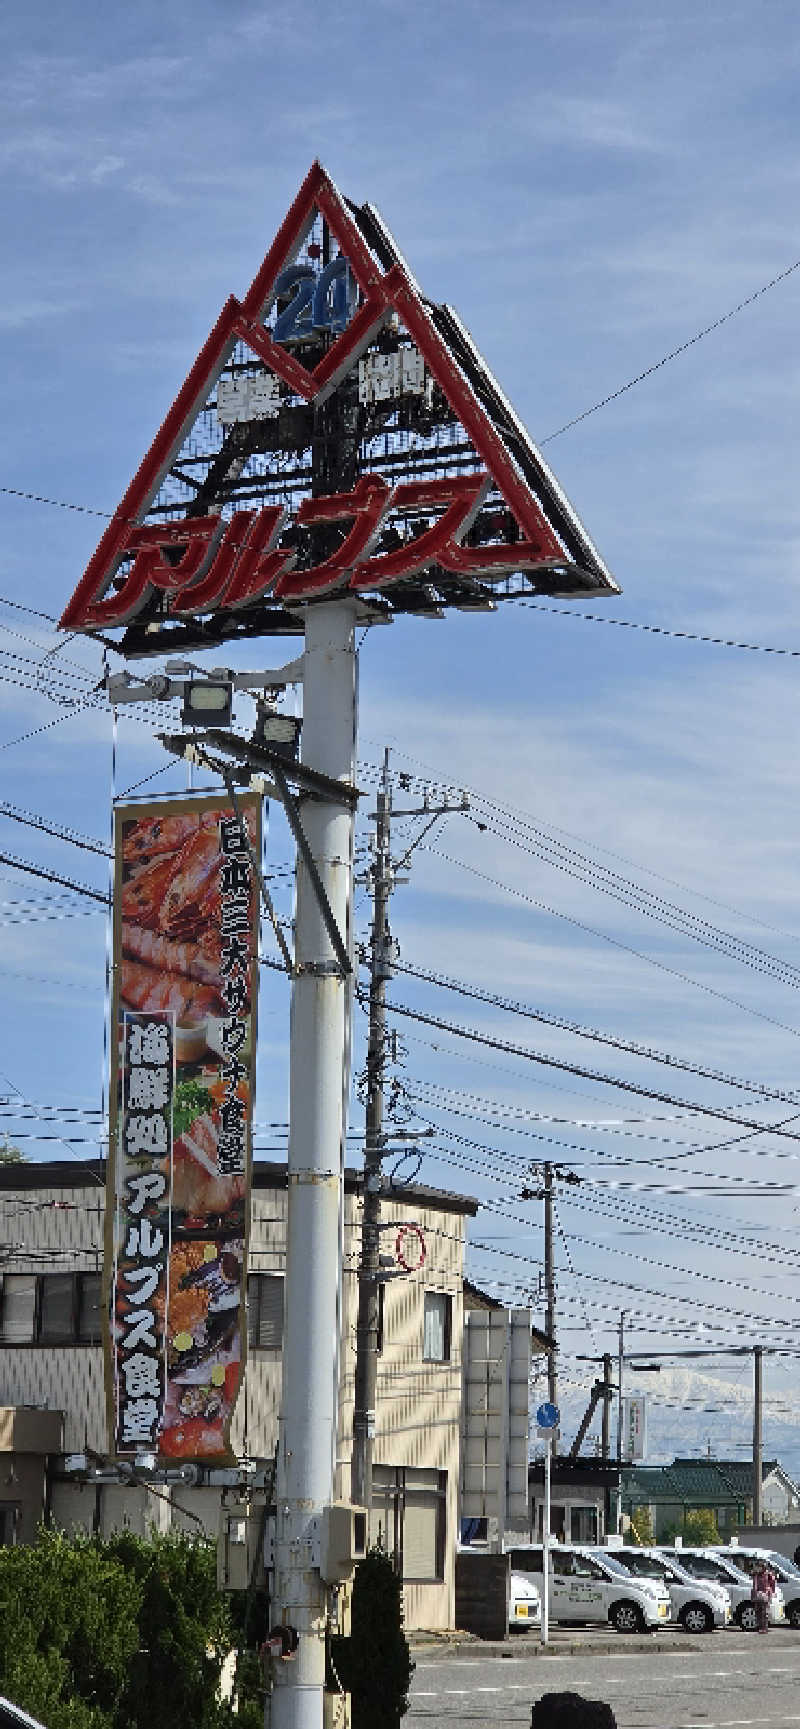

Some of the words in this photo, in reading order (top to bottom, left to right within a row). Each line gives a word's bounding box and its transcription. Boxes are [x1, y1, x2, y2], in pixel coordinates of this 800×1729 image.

[273, 256, 349, 341] 24
[86, 473, 545, 627] アルプス
[217, 817, 250, 1176] 日本三大サウナ食堂
[121, 1173, 167, 1443] アルプス食堂
